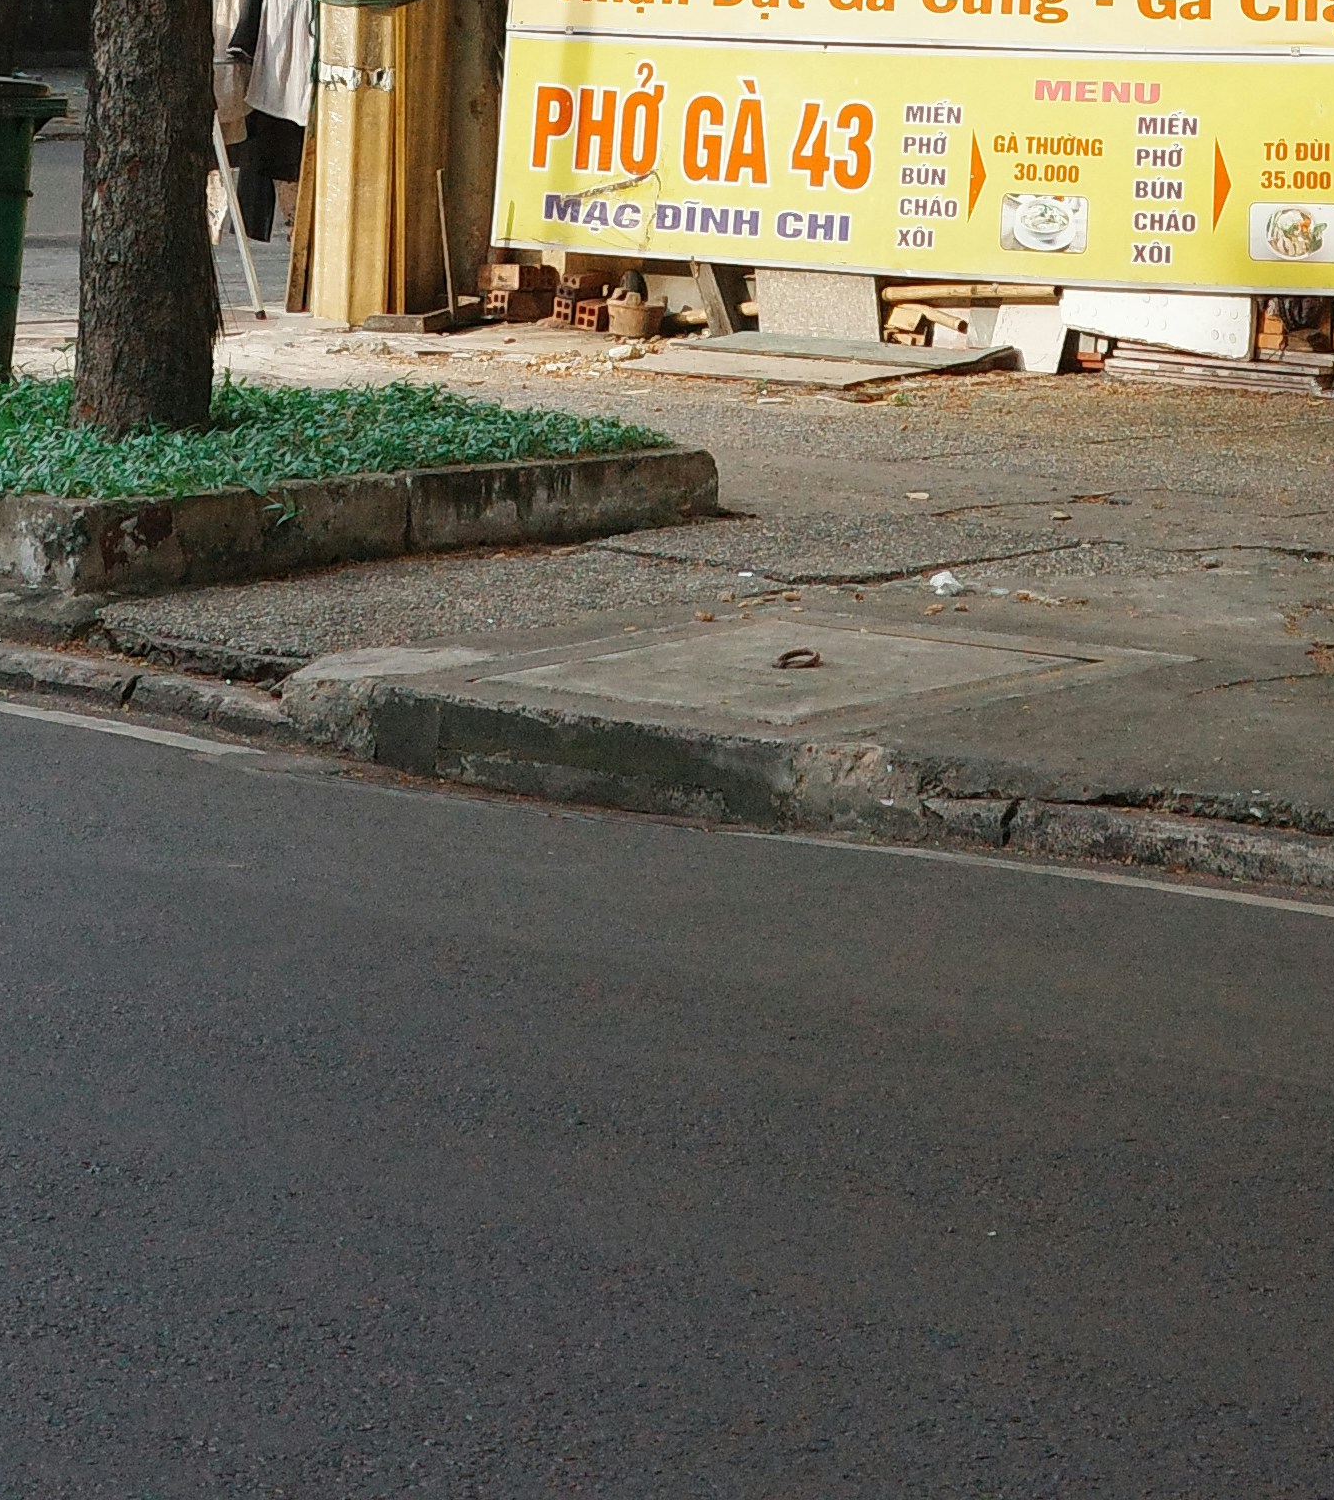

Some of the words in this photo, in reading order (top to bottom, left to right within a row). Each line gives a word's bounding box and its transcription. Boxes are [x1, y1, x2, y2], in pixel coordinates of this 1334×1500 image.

[1034, 79, 1162, 104] MENU
[905, 100, 962, 124] MIẾN
[1137, 111, 1198, 136] MIẾN
[531, 60, 666, 176] PHỞ
[682, 76, 768, 186] GÀ
[790, 102, 875, 190] 43
[903, 132, 948, 155] PHỞ
[993, 131, 1019, 155] GÀ
[1025, 133, 1104, 157] THƯỜNG
[1136, 143, 1183, 168] PHỞ
[1263, 138, 1287, 162] TÔ
[1294, 138, 1331, 162] ĐÙI
[901, 163, 946, 186] BÚN
[1014, 163, 1080, 184] 30.000
[1260, 170, 1332, 190] 35.000
[1134, 176, 1183, 200] BÚN
[543, 193, 642, 233] MẠC
[655, 199, 760, 237] ĐĨNH
[776, 210, 851, 242] CHI
[899, 195, 958, 217] CHÁO
[1133, 208, 1196, 233] CHÁO
[897, 225, 934, 248] XÔI
[1131, 240, 1172, 264] XÔI
